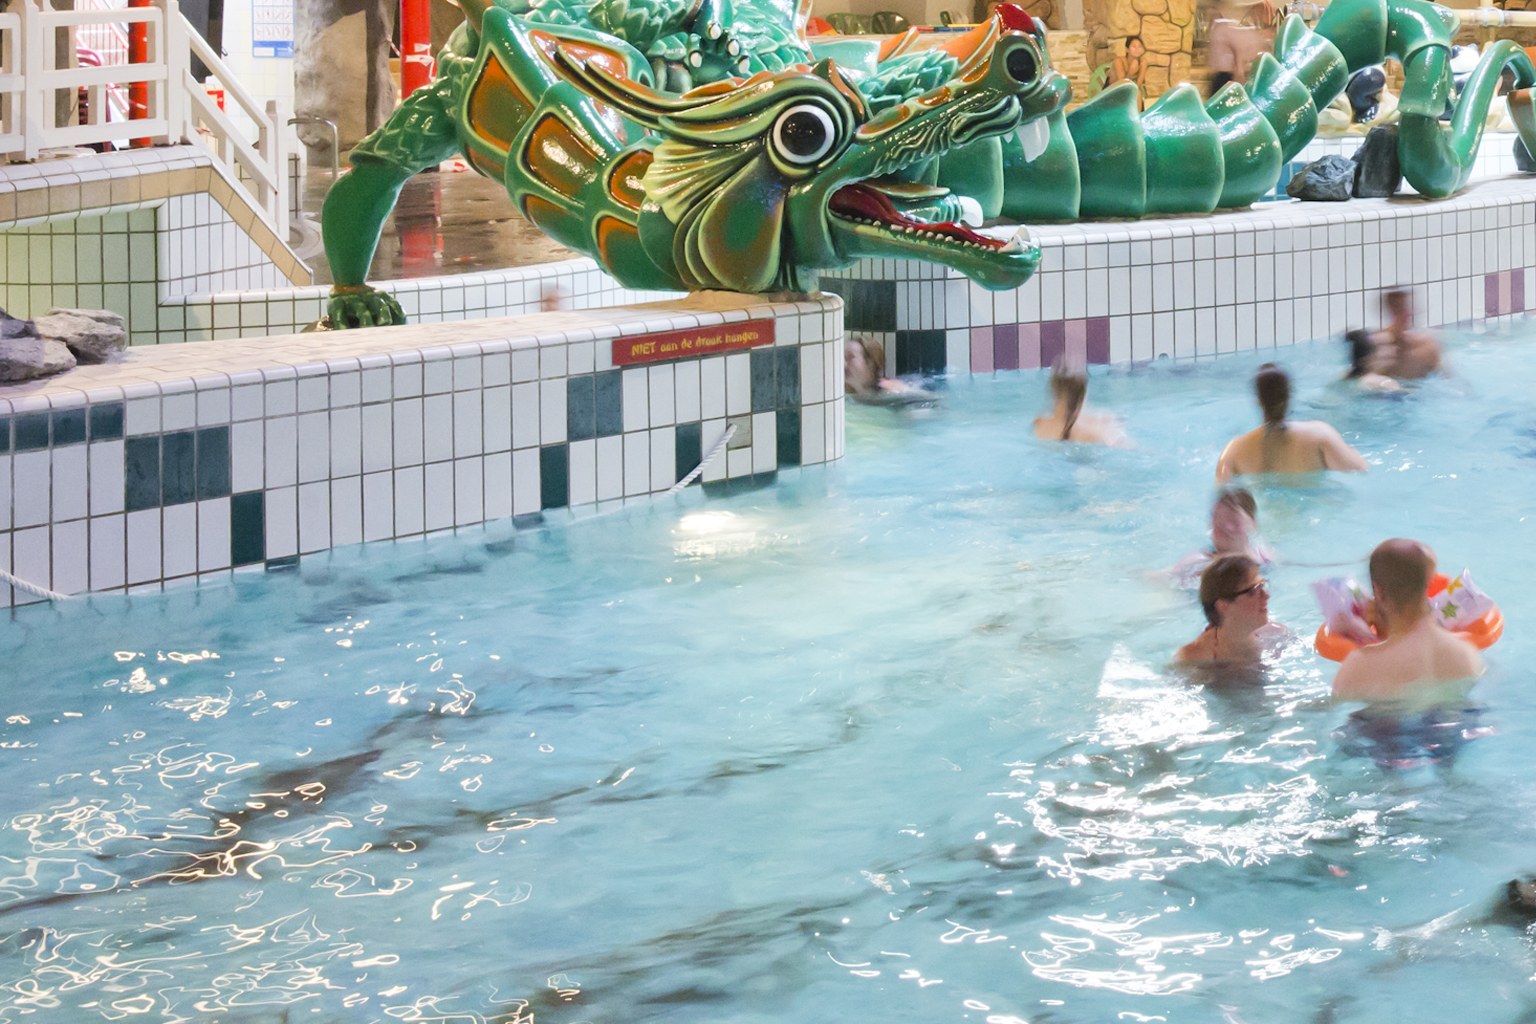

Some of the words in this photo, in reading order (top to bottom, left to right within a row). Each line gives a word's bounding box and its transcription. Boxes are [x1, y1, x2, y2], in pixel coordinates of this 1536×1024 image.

[631, 341, 656, 356] NIET
[660, 343, 678, 353] aan
[681, 338, 693, 349] de
